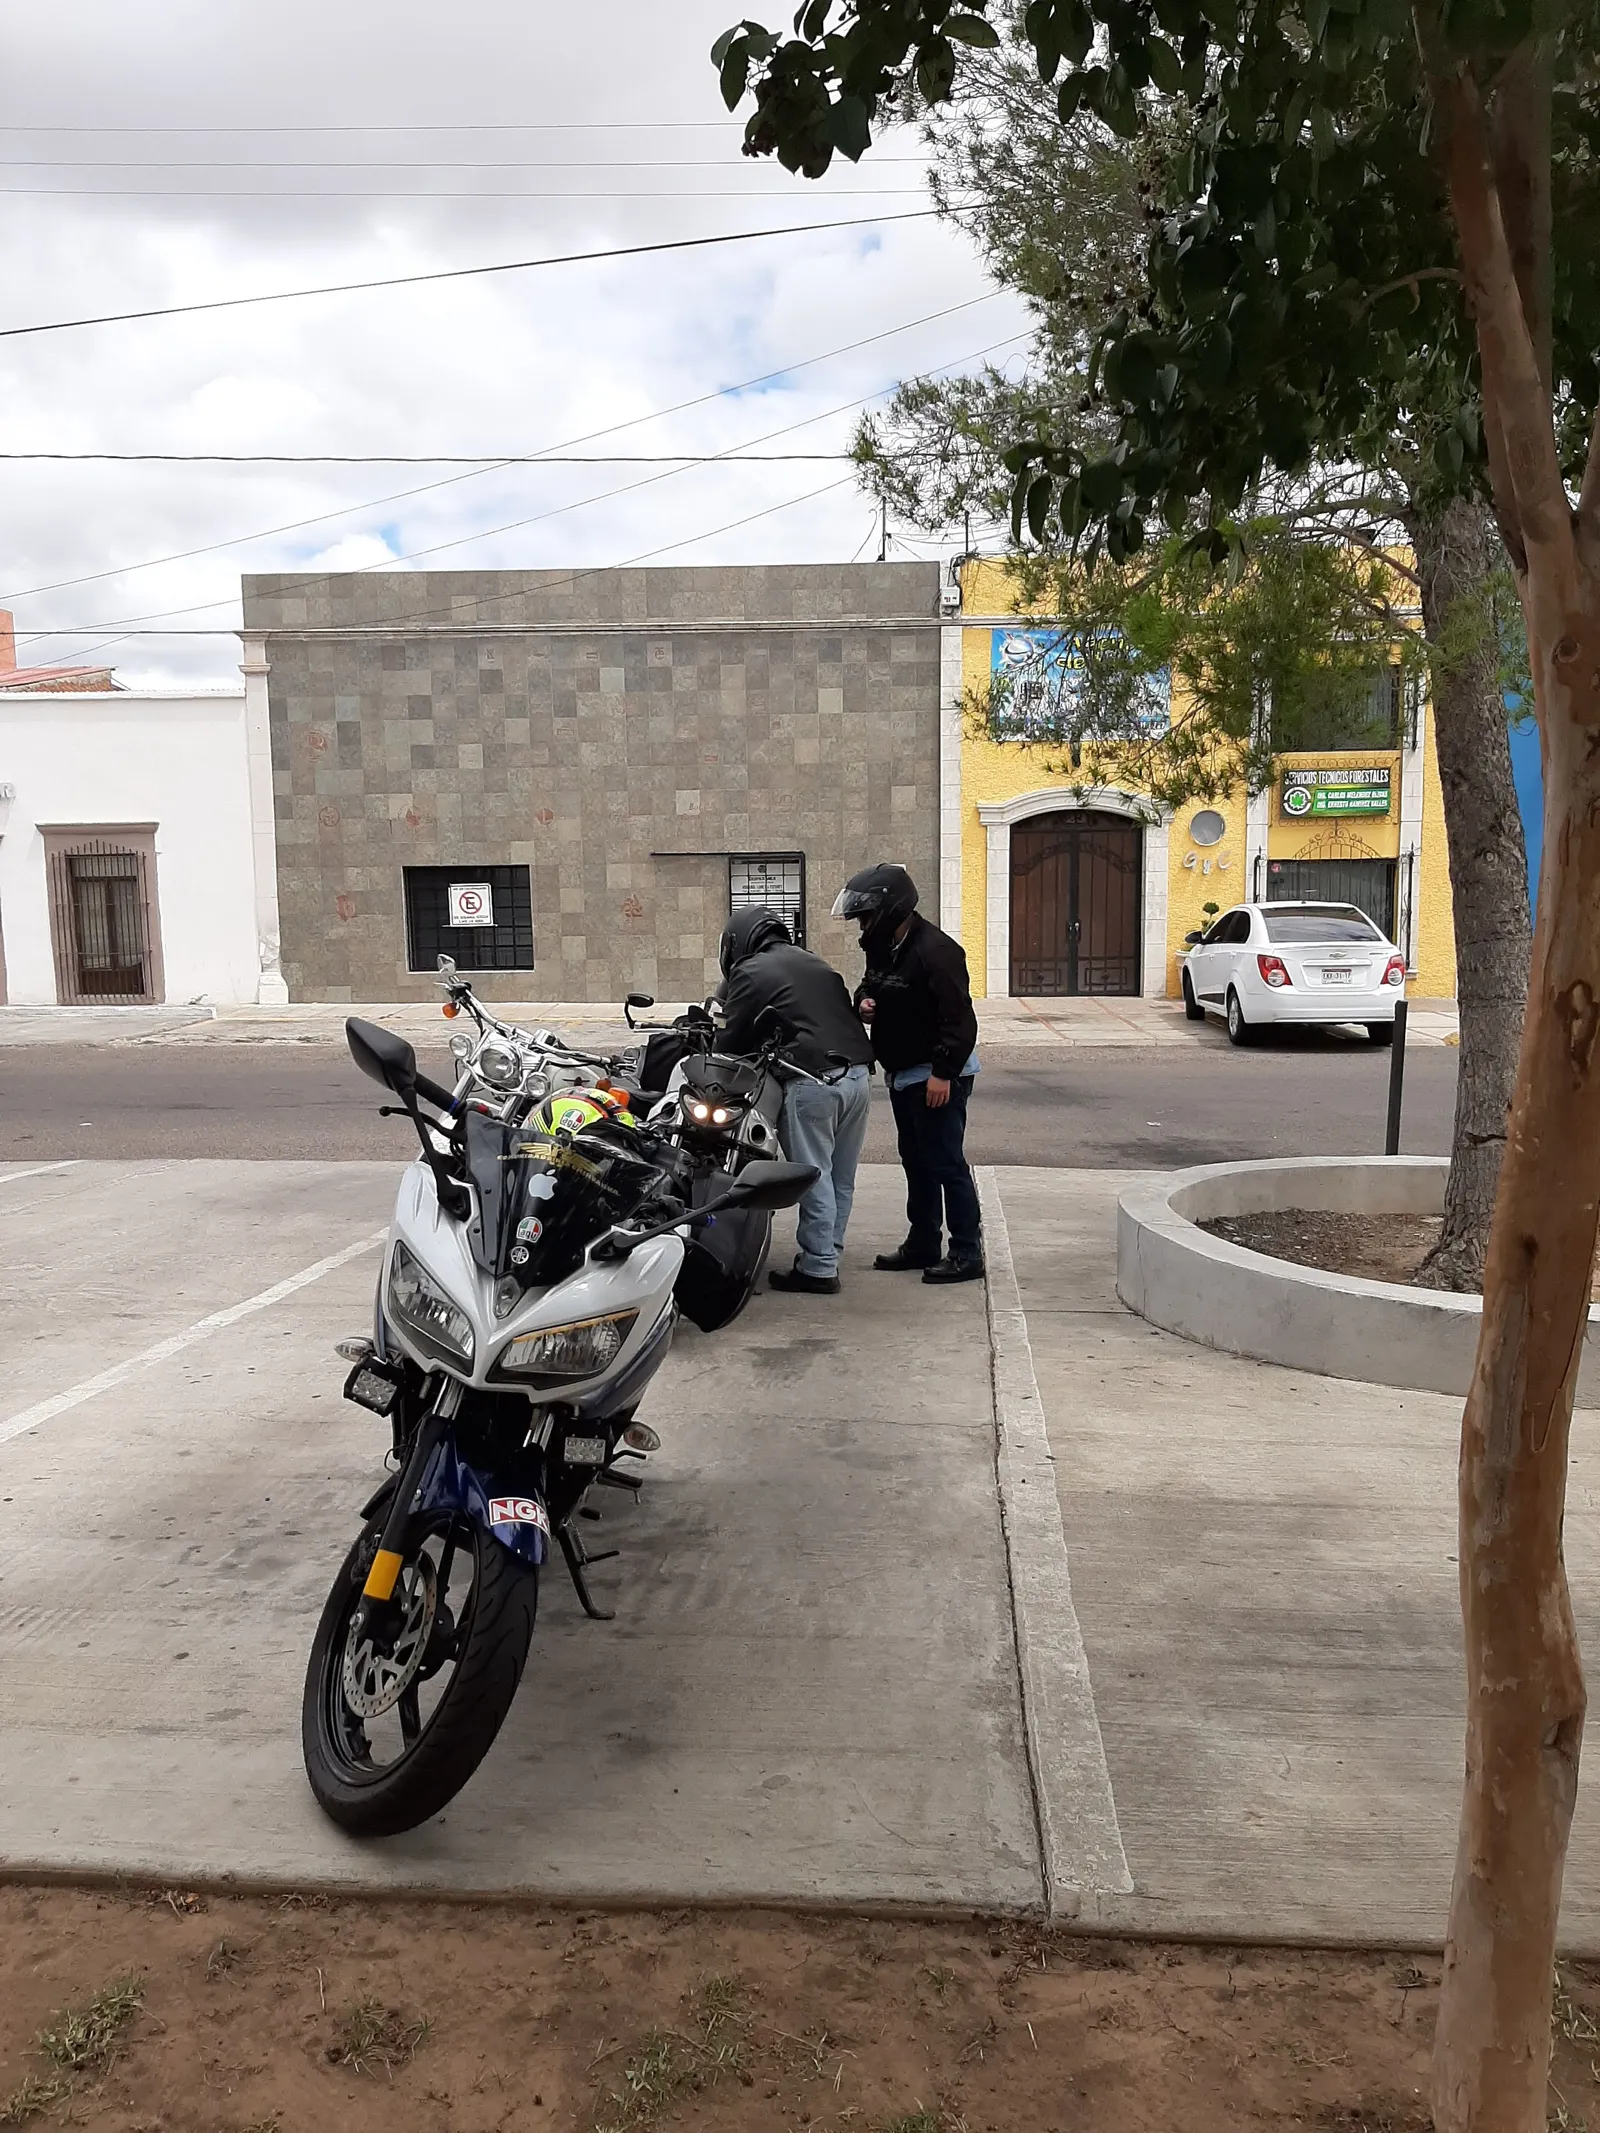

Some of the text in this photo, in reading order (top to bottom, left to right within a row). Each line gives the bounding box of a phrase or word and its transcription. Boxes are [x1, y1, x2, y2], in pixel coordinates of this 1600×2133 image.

[1284, 769, 1389, 785] SERVICIOS TECNICOS FORESTALES
[492, 1500, 548, 1532] NGK
